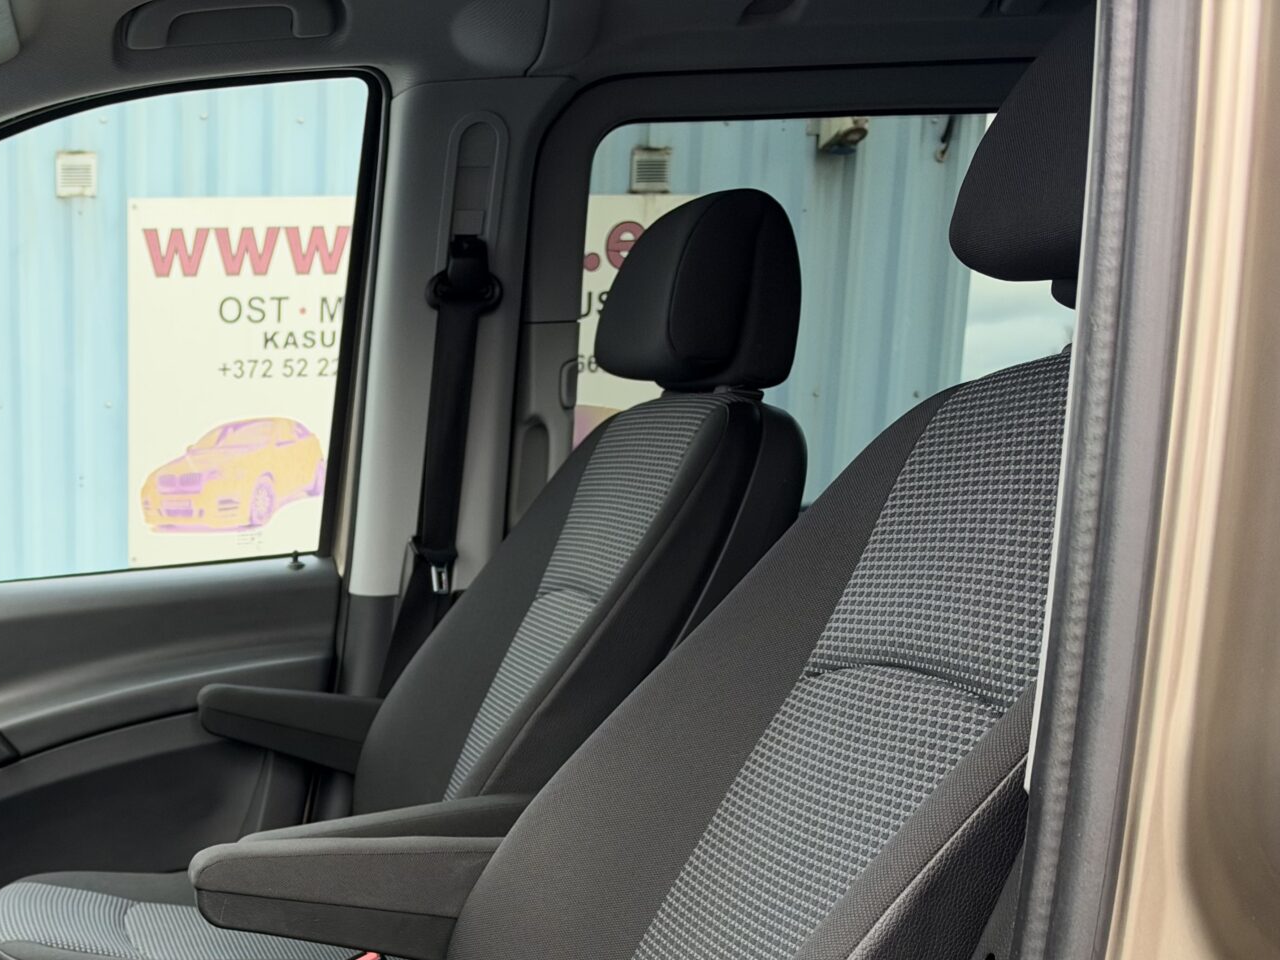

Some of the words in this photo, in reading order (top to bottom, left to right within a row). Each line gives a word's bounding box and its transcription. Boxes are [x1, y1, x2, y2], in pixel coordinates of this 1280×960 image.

[218, 296, 289, 324] OST
[263, 330, 336, 349] KASU
[218, 358, 273, 379] +372
[282, 357, 309, 378] 52
